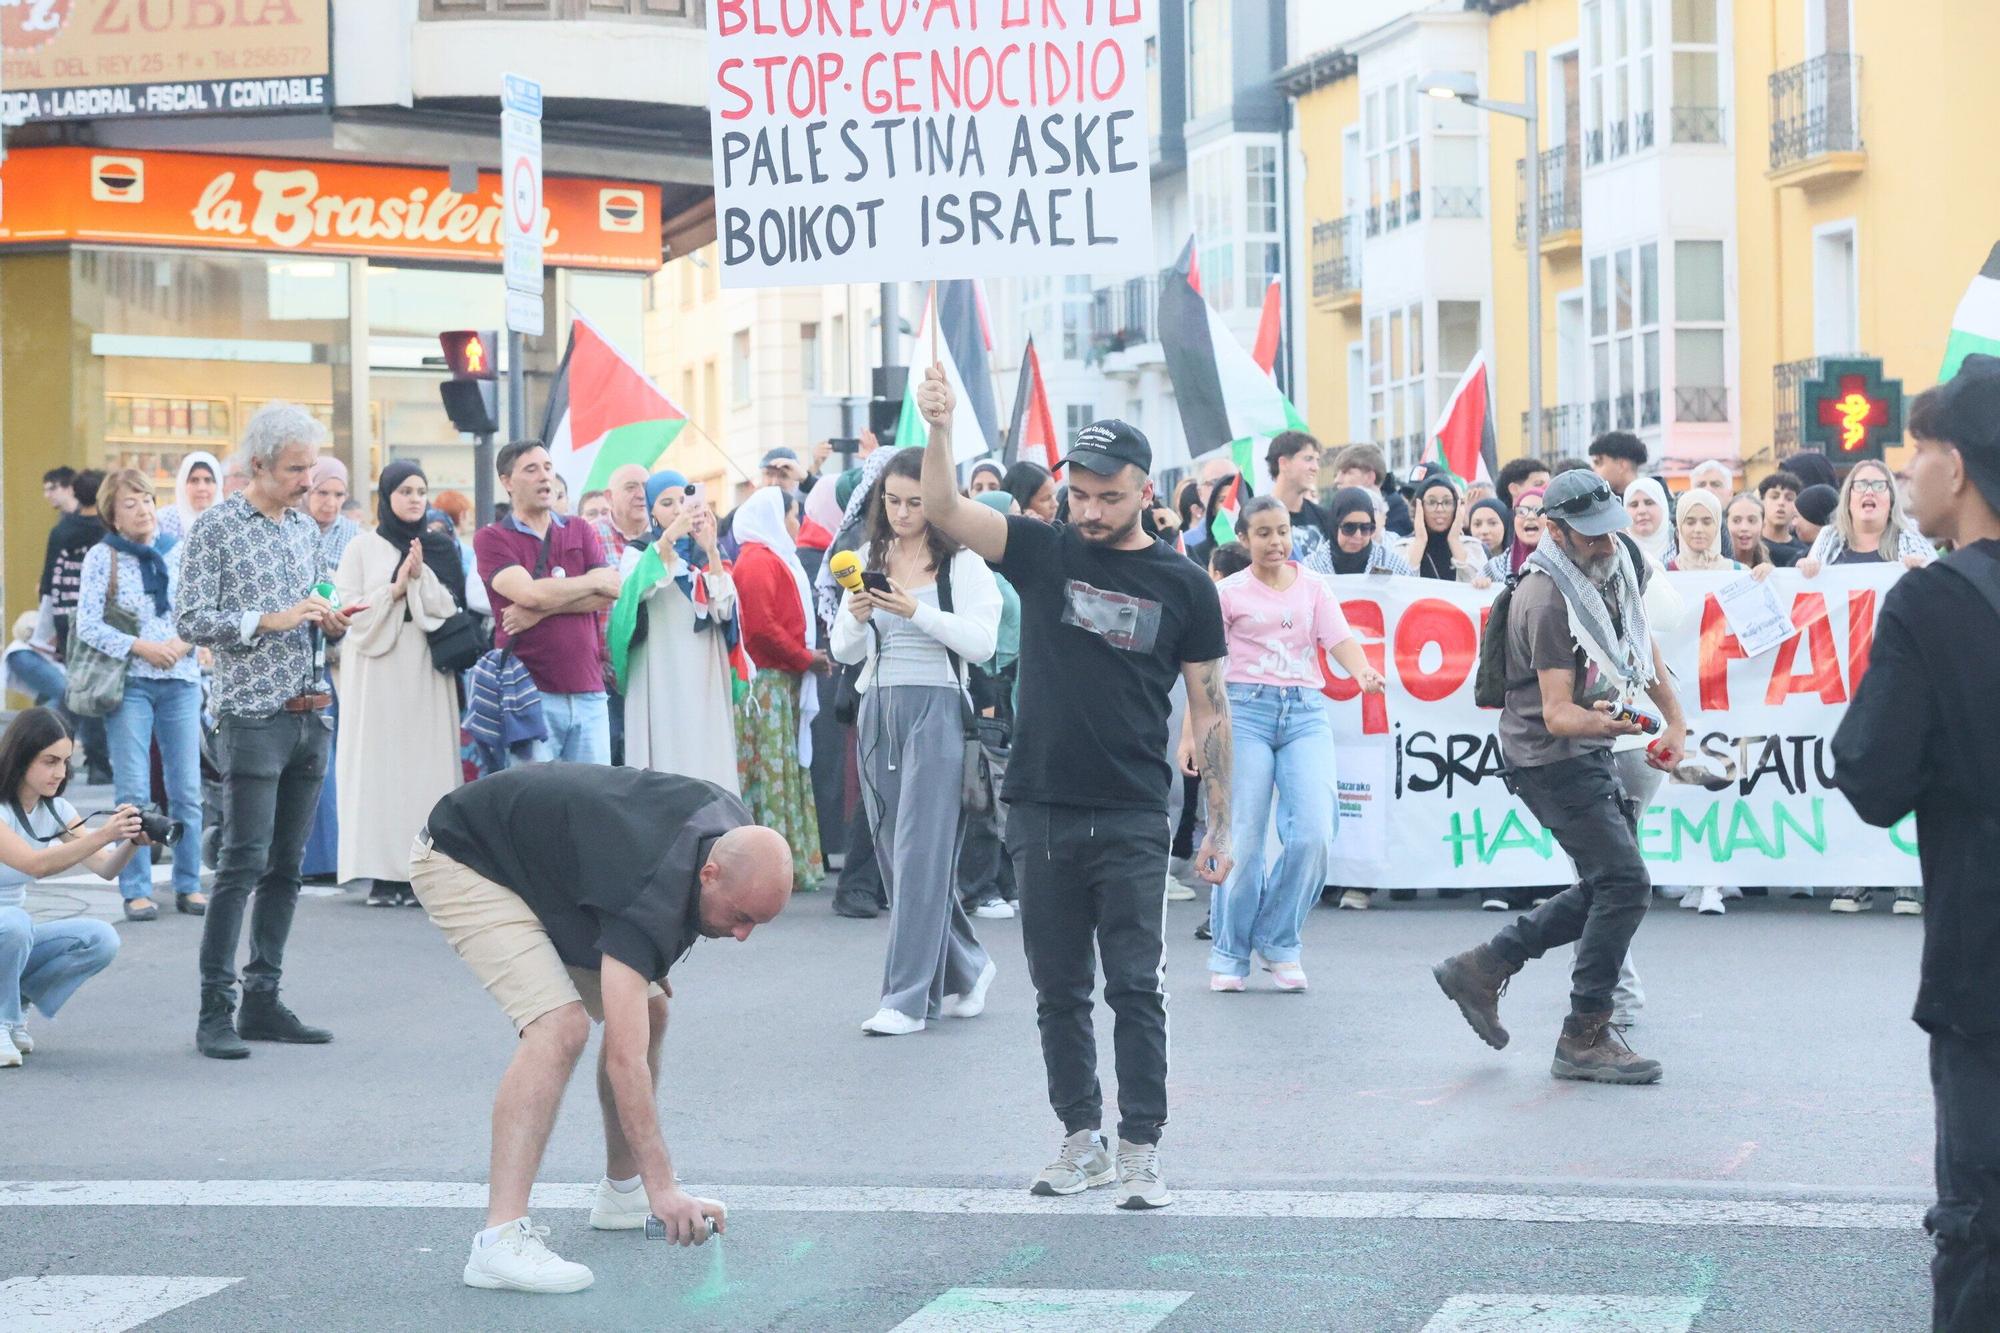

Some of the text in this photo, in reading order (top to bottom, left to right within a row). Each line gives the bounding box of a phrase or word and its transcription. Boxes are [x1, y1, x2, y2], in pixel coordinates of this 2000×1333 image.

[52, 88, 136, 116] LABORAL
[147, 84, 208, 112] FISCAL
[211, 83, 226, 108] Y
[229, 78, 323, 108] CONTABLE
[721, 109, 1138, 188] PALESTINA ASKE
[191, 172, 247, 234] la
[723, 187, 1118, 267] BOIKOT ISRAEL
